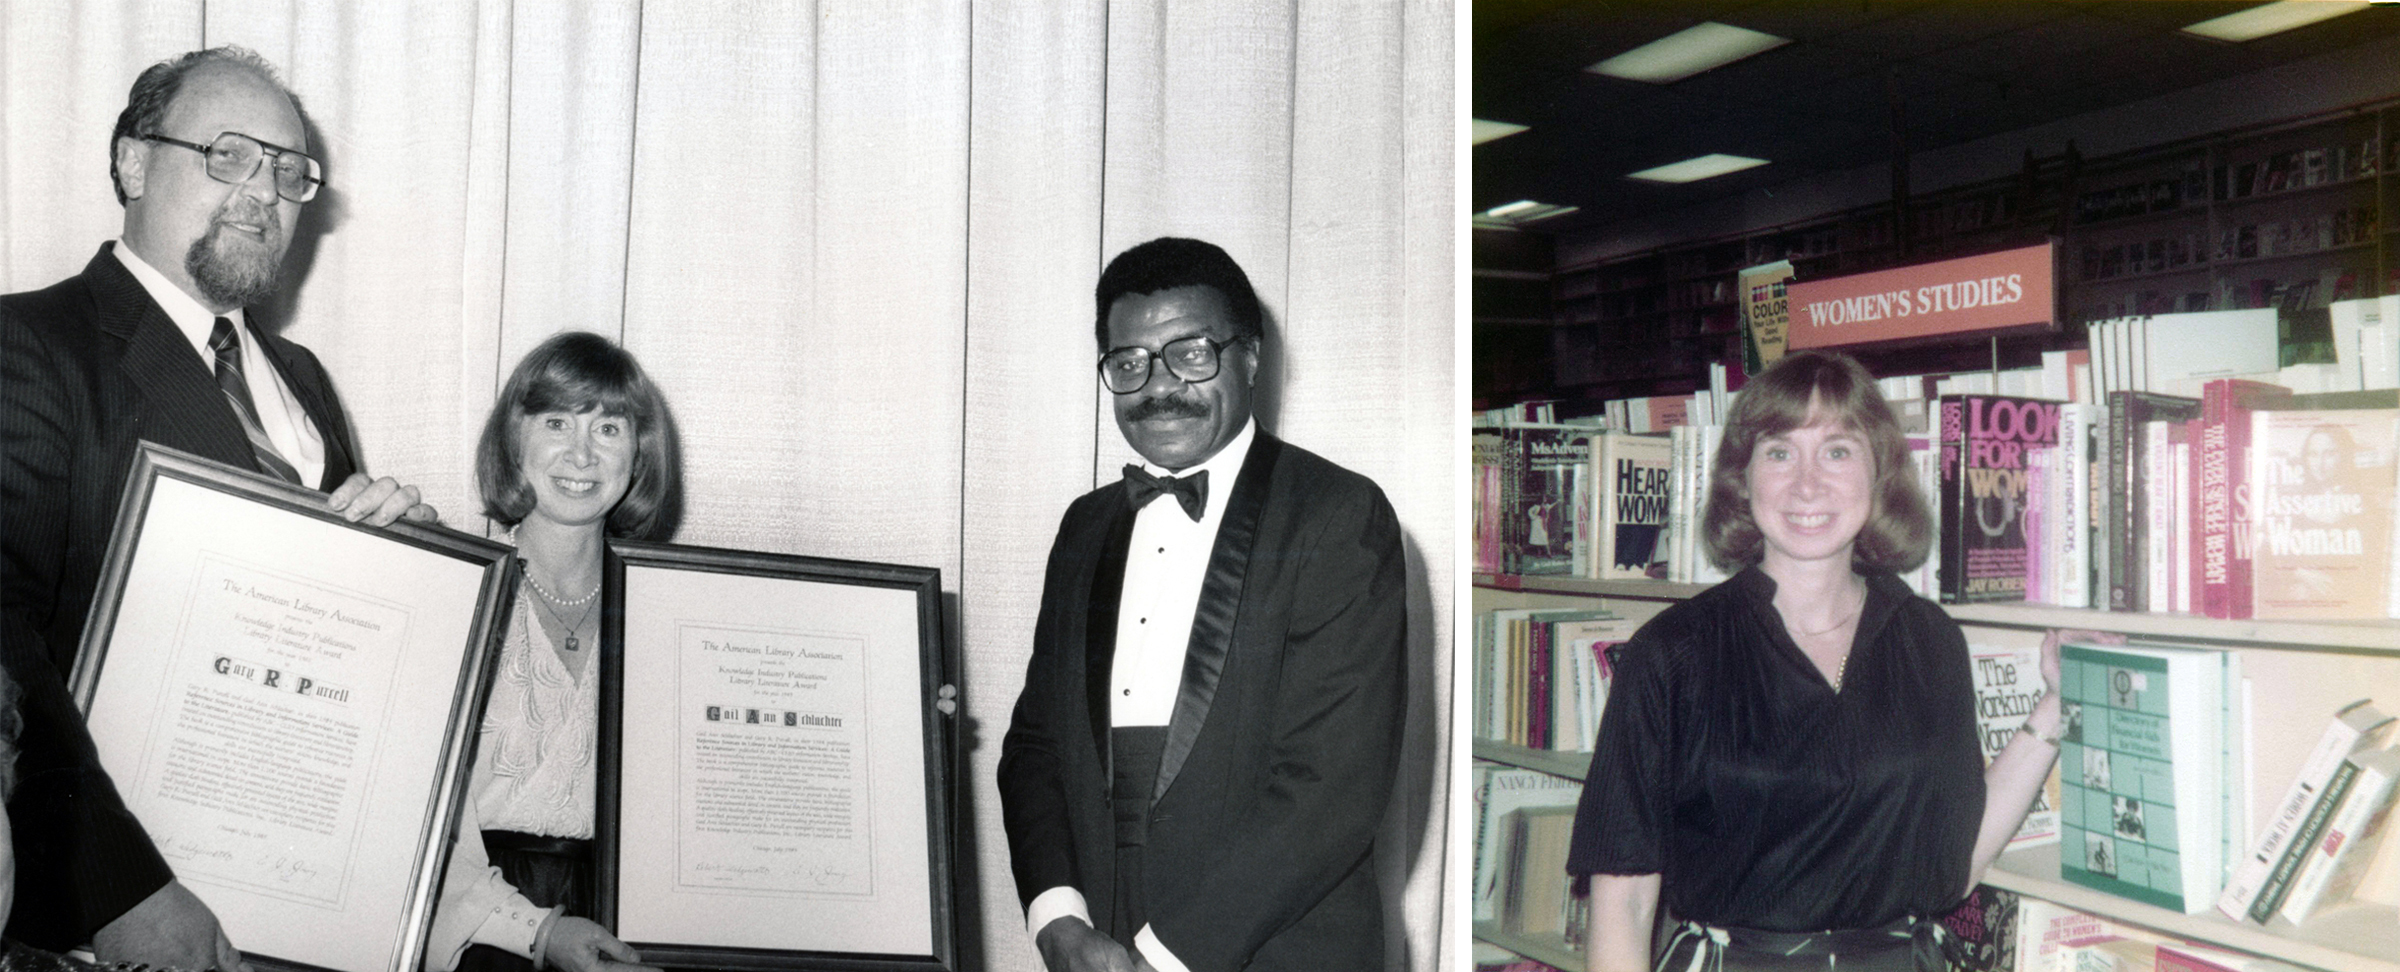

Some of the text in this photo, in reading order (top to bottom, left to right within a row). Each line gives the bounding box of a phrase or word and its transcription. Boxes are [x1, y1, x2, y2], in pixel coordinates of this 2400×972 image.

[1753, 299, 1788, 319] COLOR
[1808, 273, 2023, 328] WOMEN'S STUDIES
[2064, 411, 2075, 452] LIVING
[1970, 439, 2022, 469] FOR
[2268, 457, 2304, 485] The
[2266, 486, 2364, 516] Assertive
[2267, 516, 2364, 556] Woman
[224, 579, 380, 631] The American Library Association
[235, 613, 356, 651] Knowledge Industry Publications
[246, 627, 342, 659] Library Literature Award
[702, 640, 843, 660] The American Library Association
[214, 657, 254, 681] Gary
[296, 677, 349, 702] Purcell
[719, 666, 827, 683] Knowledge Industry Publications
[730, 676, 817, 690] Library Literature Award
[1979, 658, 2017, 687] The
[707, 706, 842, 727] Gail Ann Schlachter
[1498, 775, 1537, 790] NANCY
[2282, 788, 2308, 824] WOMEN
[2275, 818, 2291, 834] AT
[2260, 828, 2285, 858] WORK
